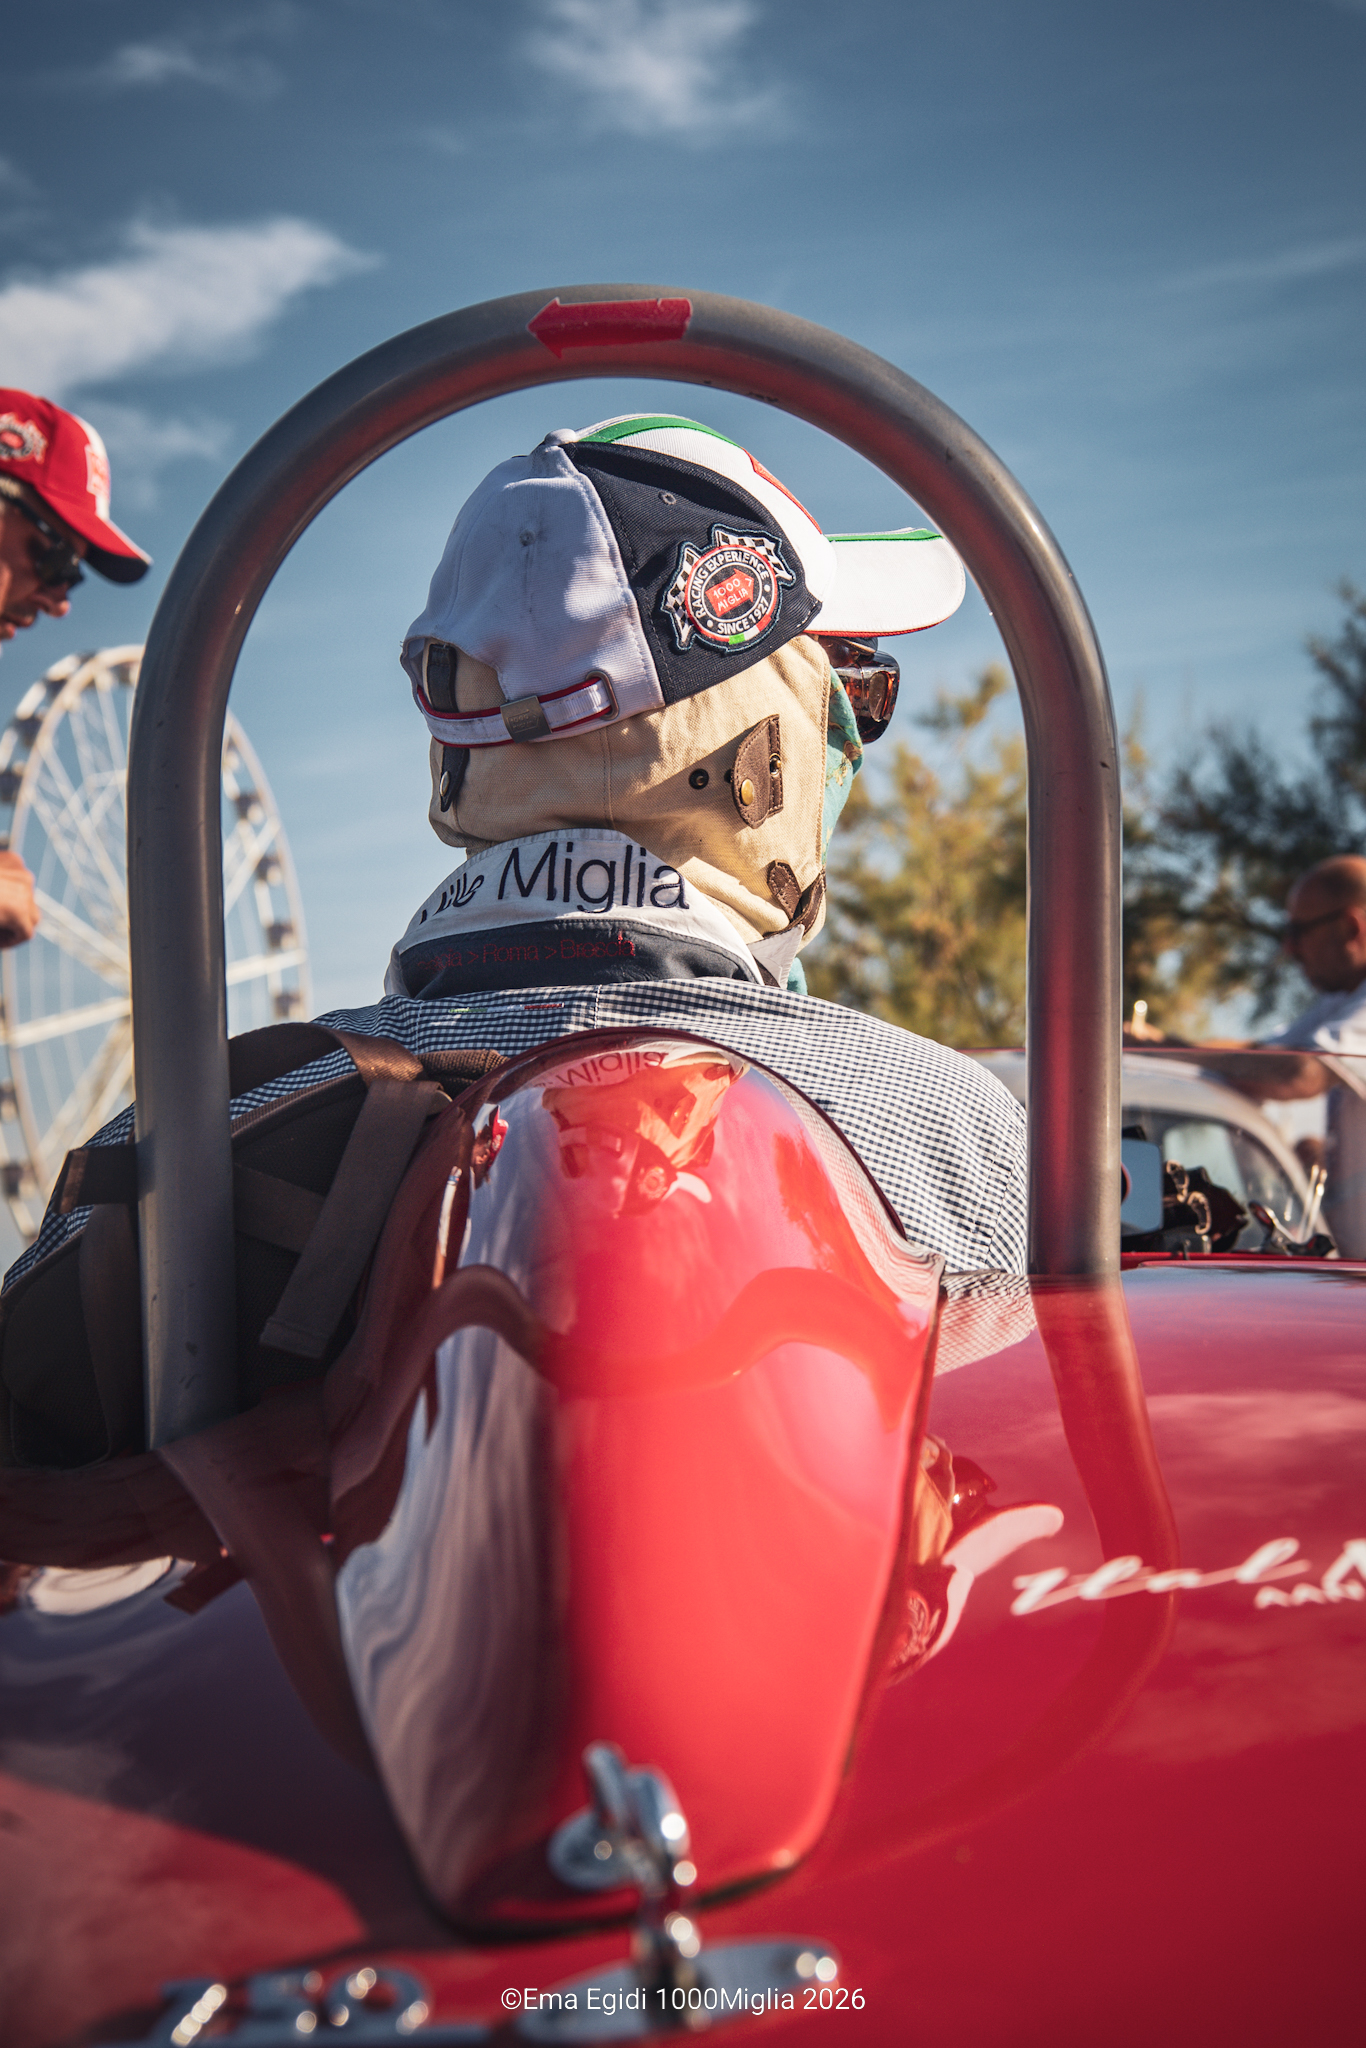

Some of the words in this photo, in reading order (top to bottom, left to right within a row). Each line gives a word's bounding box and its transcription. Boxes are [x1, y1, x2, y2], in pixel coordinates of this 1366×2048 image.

[690, 568, 709, 618] RACING
[705, 551, 769, 580] EXPERIENCE
[713, 578, 741, 599] 1000
[717, 588, 748, 612] MIGLIA
[717, 620, 750, 635] SINCE
[750, 596, 769, 624] 1927
[498, 841, 690, 914] Miglia
[483, 943, 540, 964] Roma
[560, 937, 636, 960] Brescia
